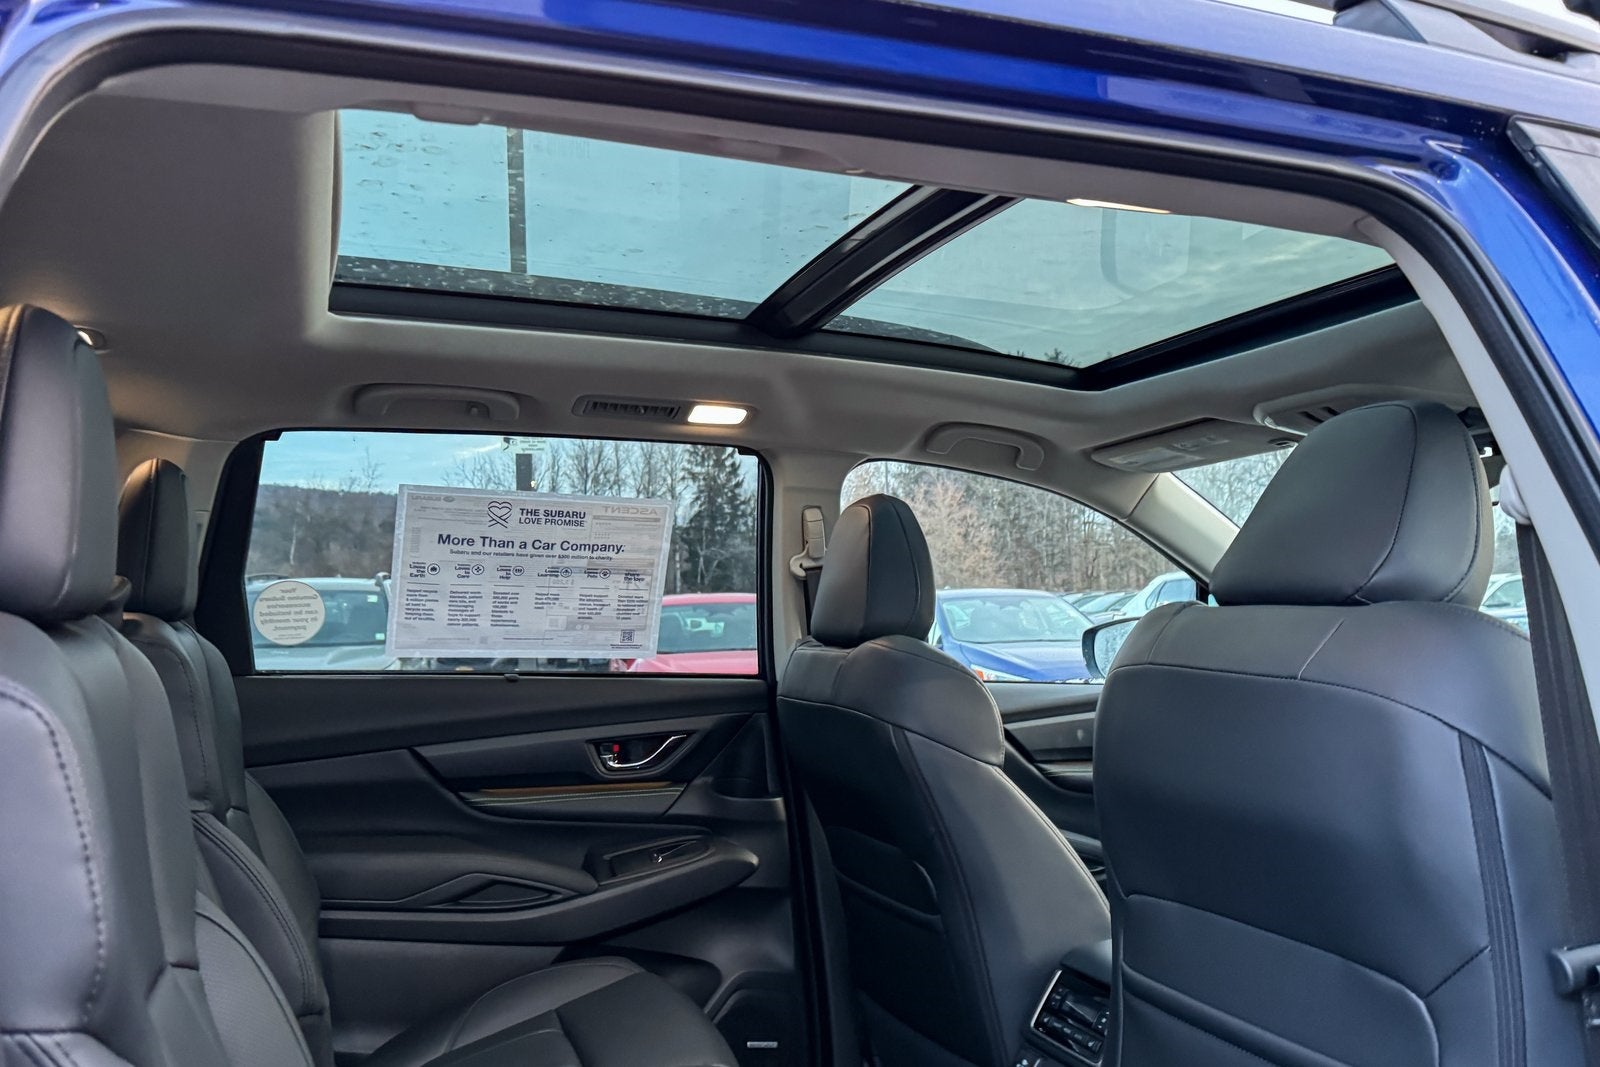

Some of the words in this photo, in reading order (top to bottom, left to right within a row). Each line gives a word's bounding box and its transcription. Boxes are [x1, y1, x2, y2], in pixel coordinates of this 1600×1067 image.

[519, 508, 541, 517] THE
[543, 509, 586, 520] SUBARU
[518, 517, 543, 525] LOVE
[544, 518, 586, 528] PROMISE
[437, 533, 475, 547] More
[480, 536, 514, 549] Than
[518, 540, 528, 550] a
[531, 540, 557, 551] Car
[560, 540, 626, 555] Company.
